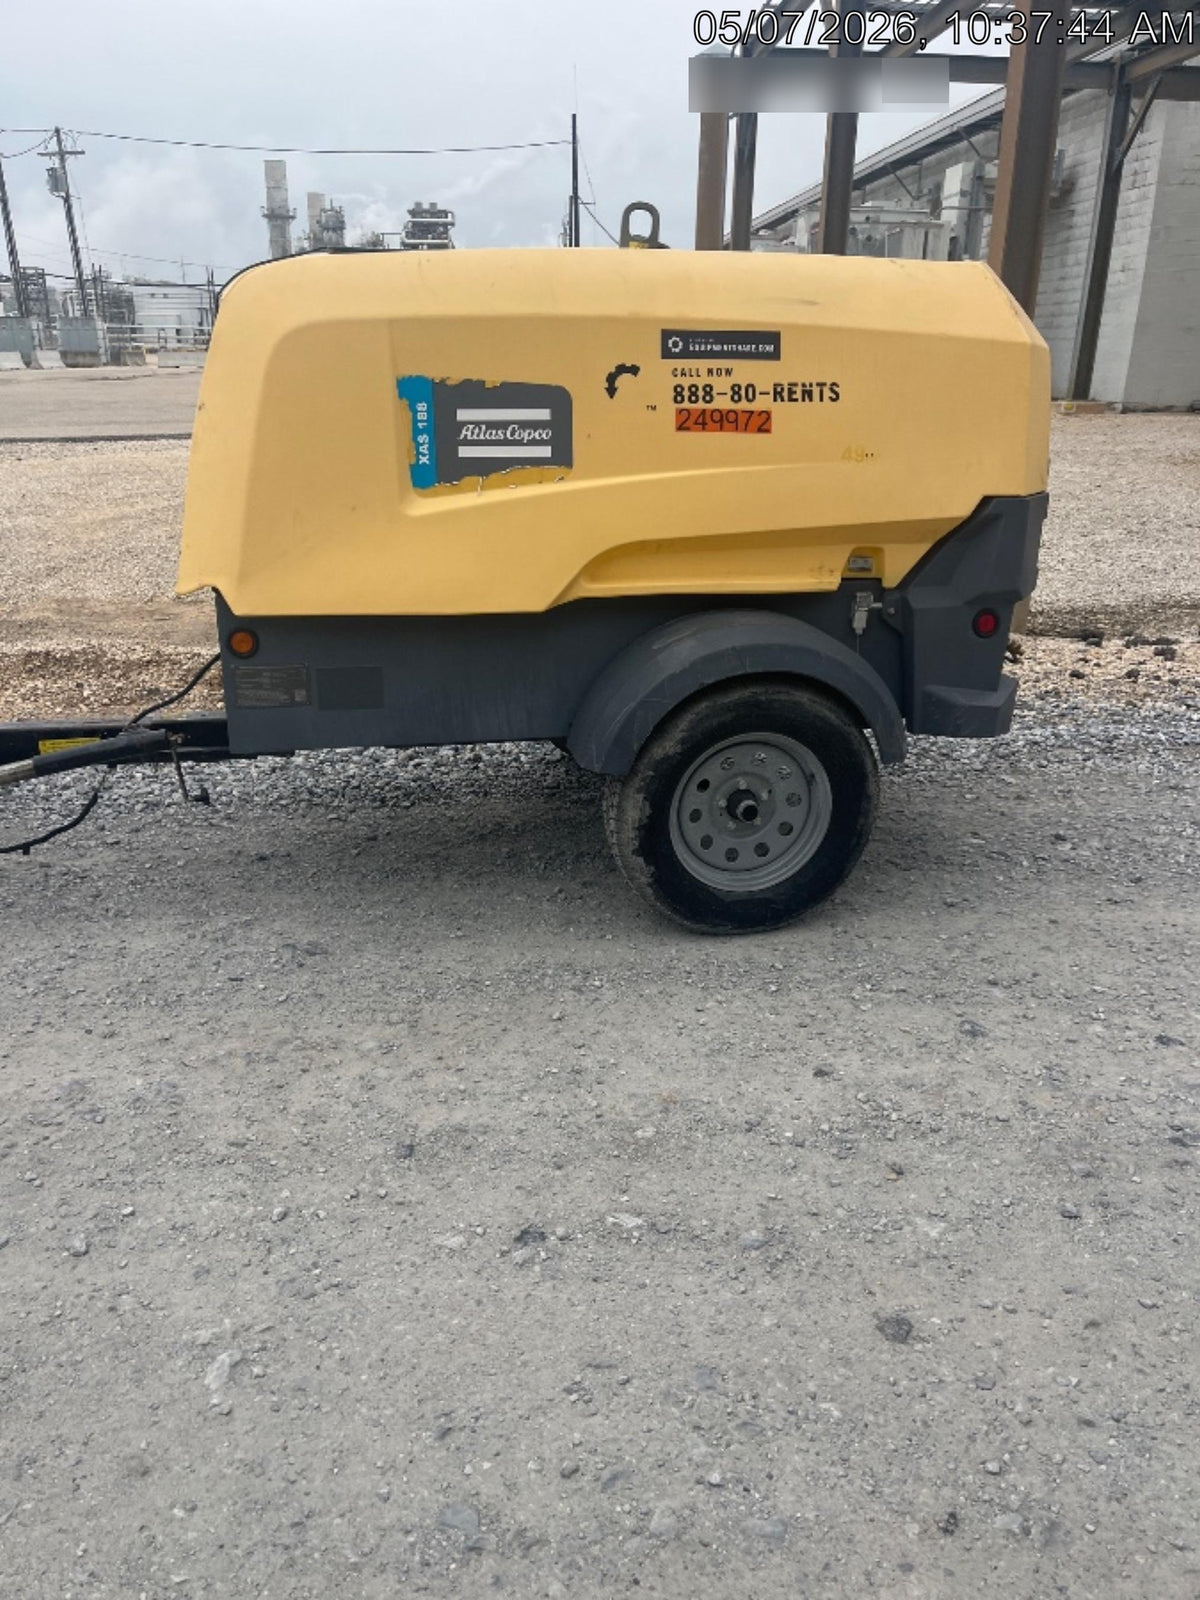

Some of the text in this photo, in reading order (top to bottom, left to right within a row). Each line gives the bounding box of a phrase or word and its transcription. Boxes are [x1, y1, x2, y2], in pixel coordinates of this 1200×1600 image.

[671, 367, 734, 378] CALL NOW
[673, 382, 840, 404] 888-80-RENTS
[676, 408, 771, 433] 249972
[416, 402, 430, 465] XAS 188
[459, 424, 552, 443] Atlas Copco
